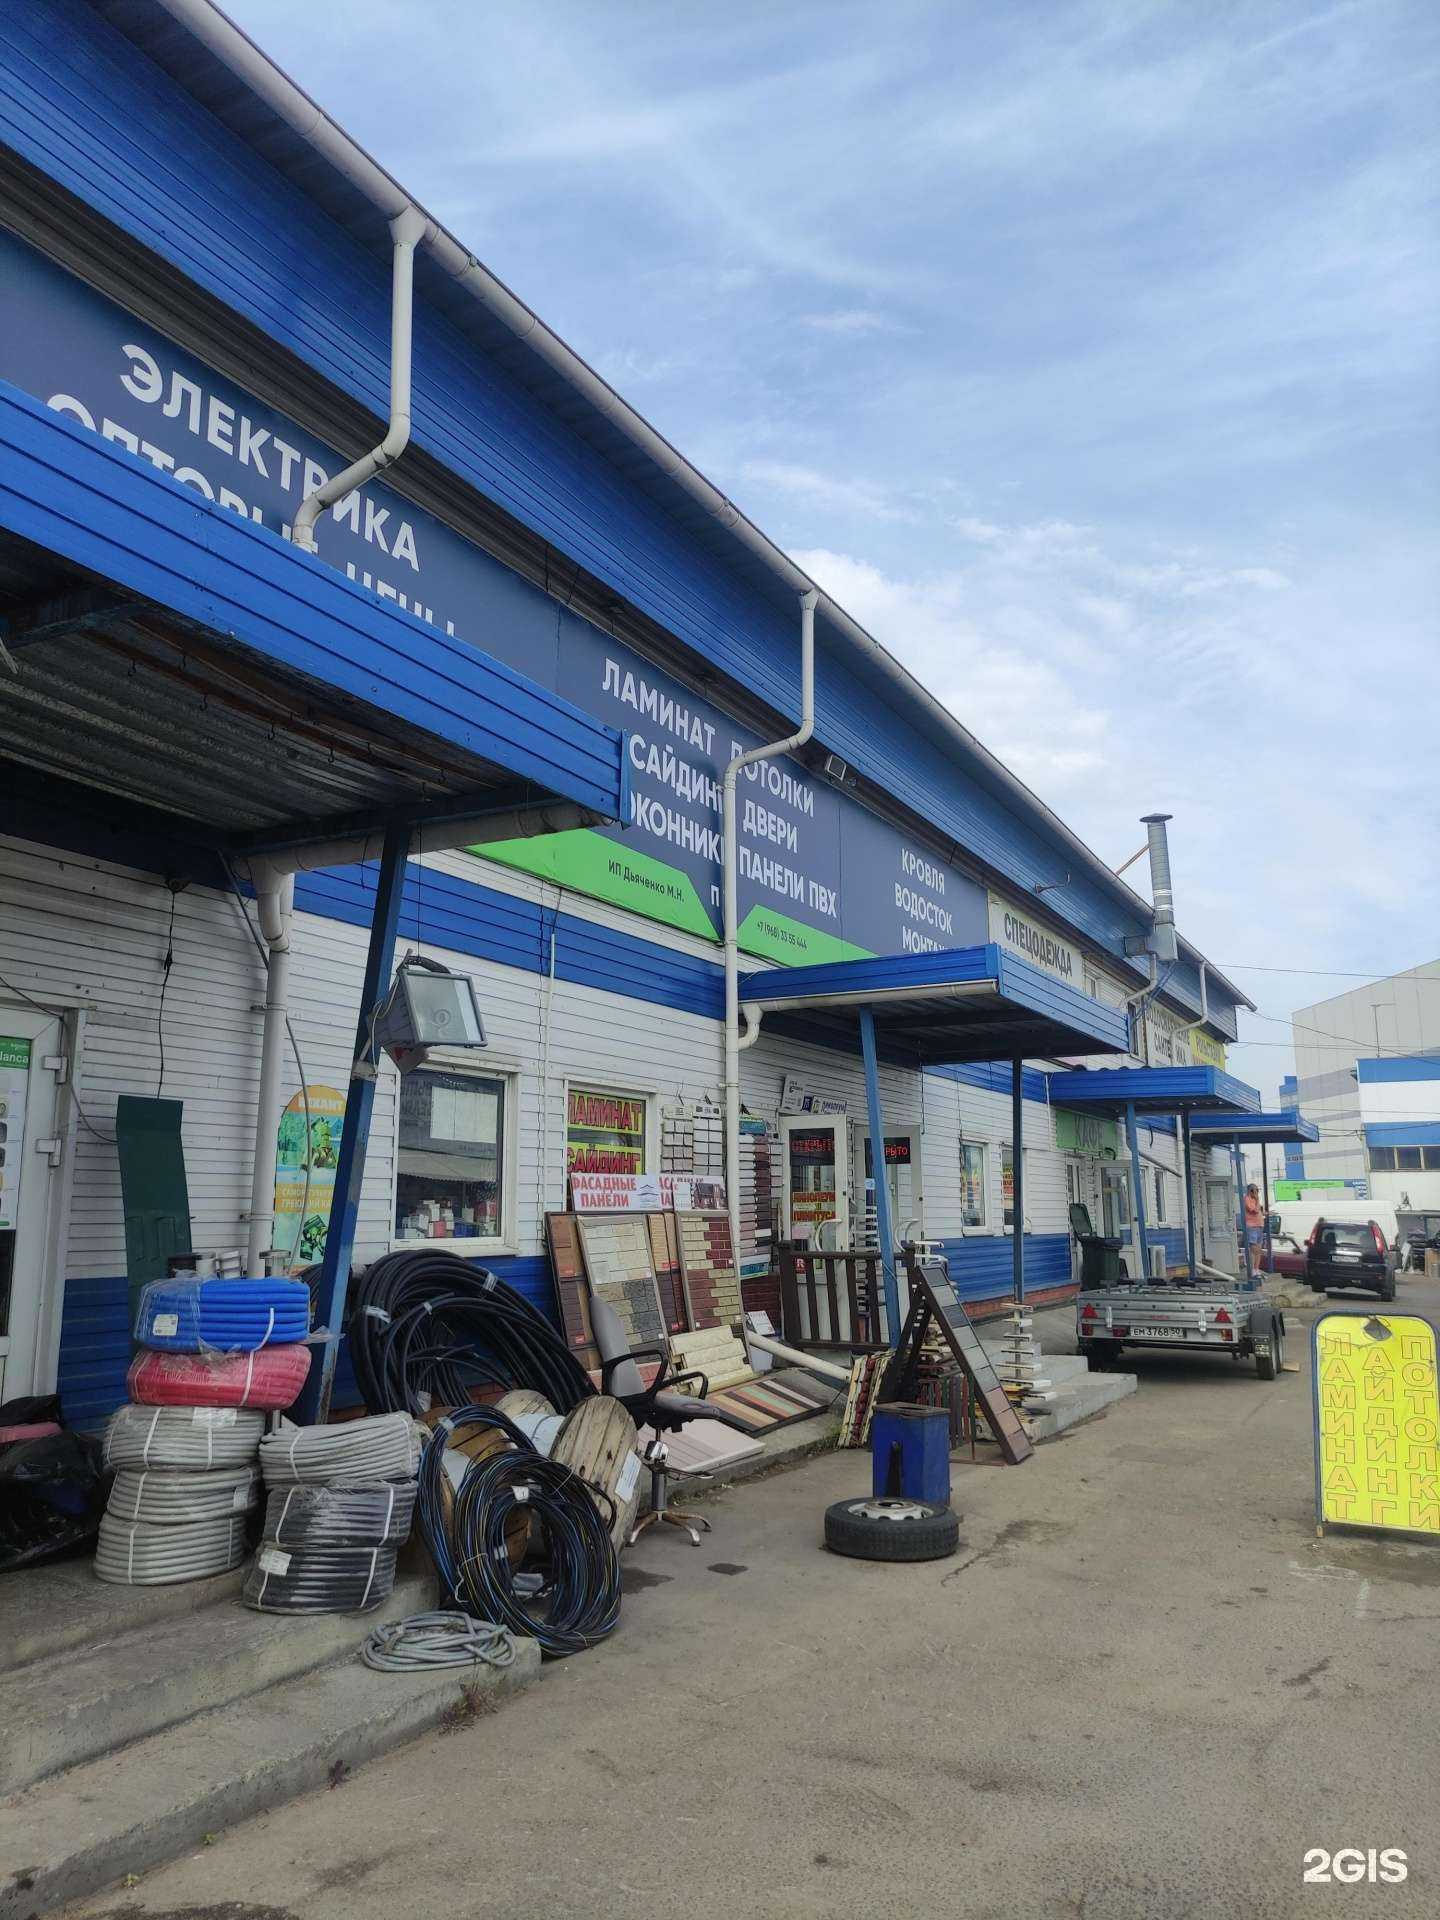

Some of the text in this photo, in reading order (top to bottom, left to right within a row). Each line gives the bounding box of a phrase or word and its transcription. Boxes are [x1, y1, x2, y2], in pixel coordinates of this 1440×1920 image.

[120, 344, 420, 573] ЭЛЕКТРИКА
[602, 657, 716, 757] ЛАМИНАТ
[742, 799, 799, 854] ДВЕРИ
[608, 859, 685, 902] ИП Дьяченко М.Н.
[630, 791, 837, 918] КОННИК ПАНЕЛИ ПВХ
[901, 847, 945, 896] КРОВЛЯ
[894, 882, 953, 936] ВОДОСТОК
[1004, 912, 1073, 979] СПЕЦОДЕЖДА
[568, 1093, 642, 1132] ЛАМИНАТ
[572, 1176, 637, 1195] ФАСАДНЫЕ
[581, 1193, 630, 1208] ПАНЕЛИ
[1321, 1331, 1358, 1519] ЛАМИНАТ
[1401, 1335, 1440, 1530] ПОТОЛКИ
